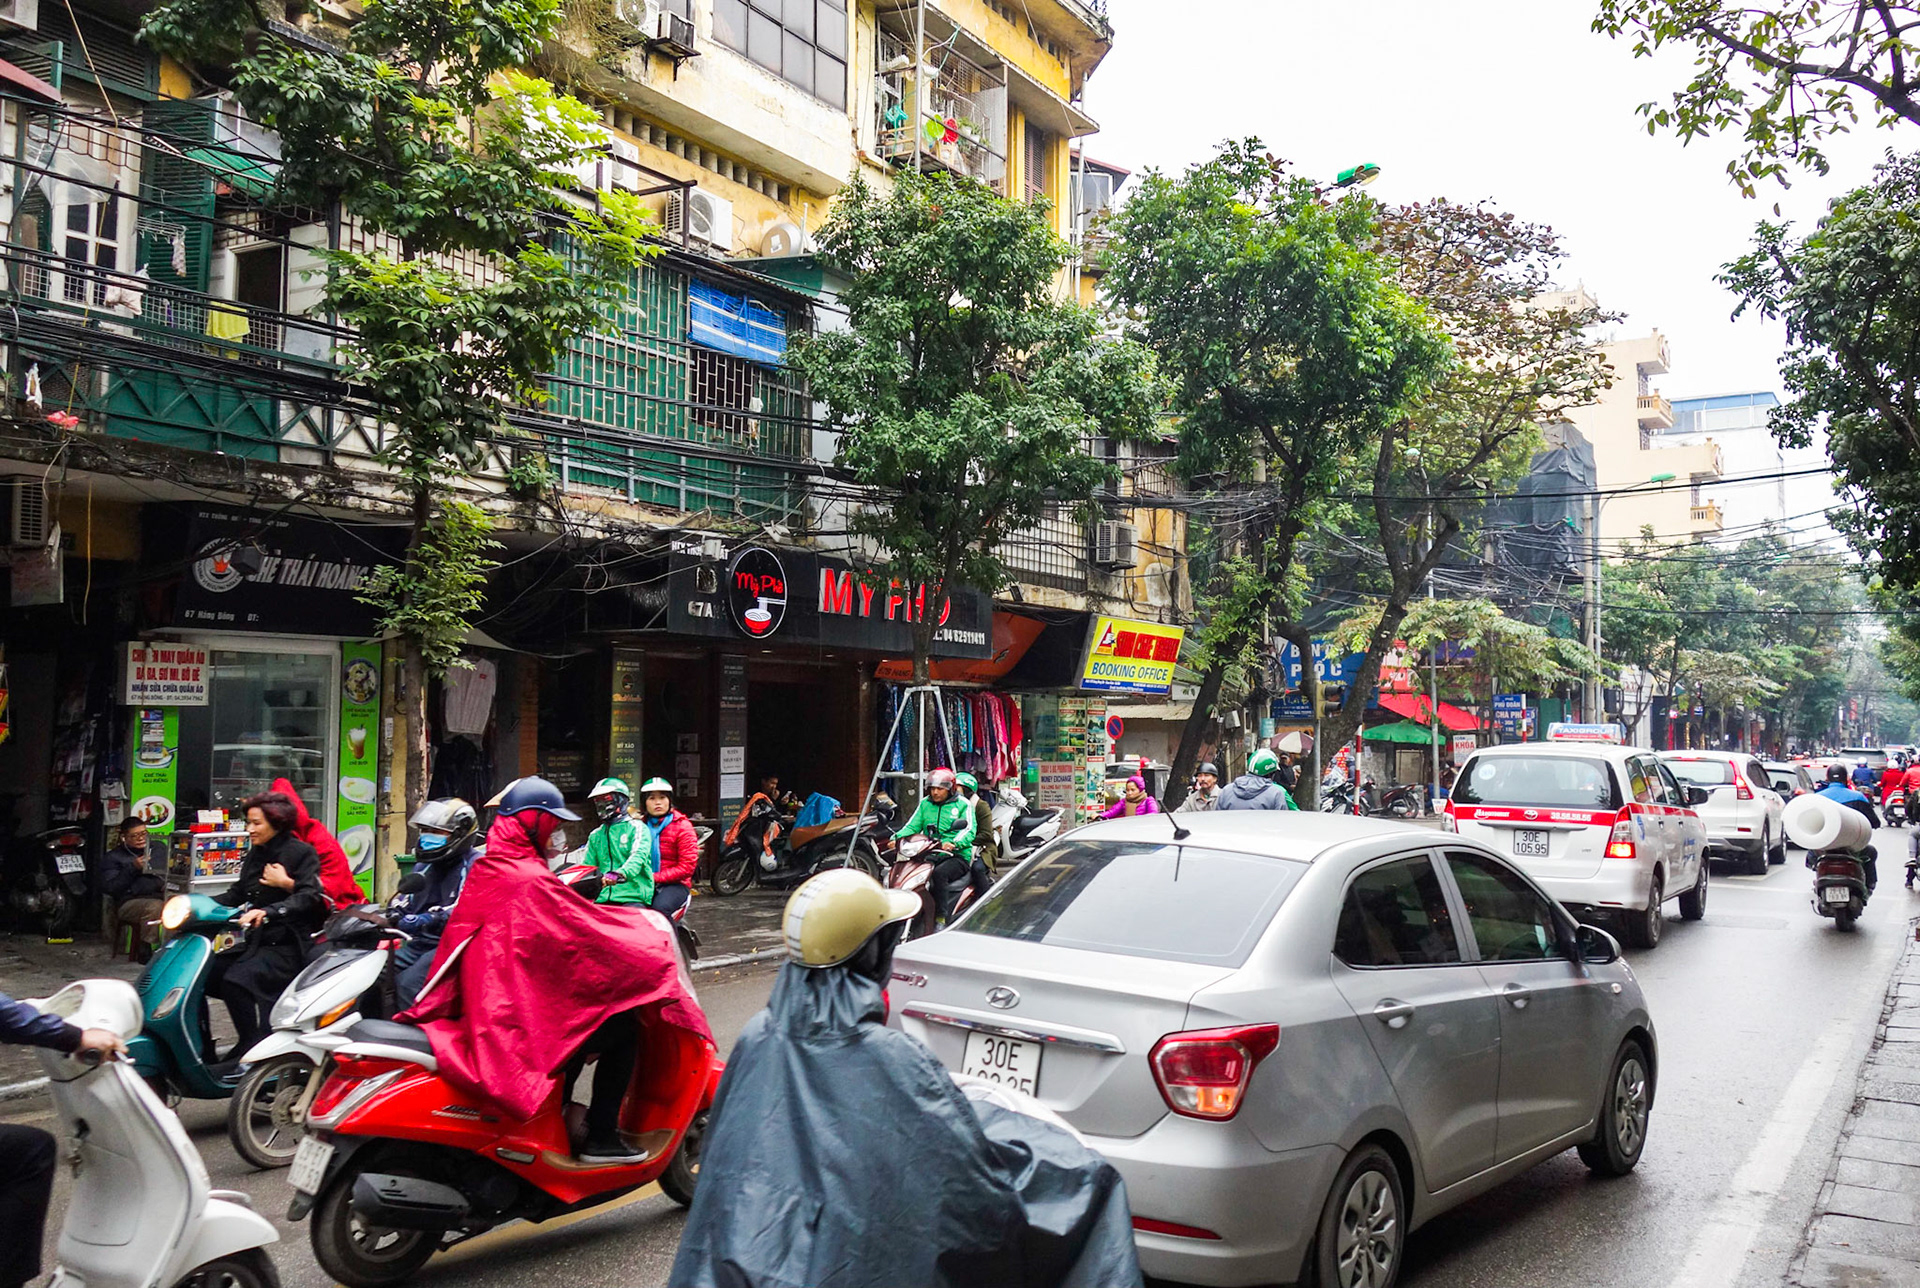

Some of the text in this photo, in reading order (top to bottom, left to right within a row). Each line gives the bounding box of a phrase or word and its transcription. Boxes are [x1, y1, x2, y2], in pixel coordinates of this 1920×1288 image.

[1091, 661, 1168, 681] BOOKING OFFICE
[1522, 831, 1540, 843] 30E
[1516, 842, 1547, 855] 105.95
[981, 1037, 1022, 1071] 30E
